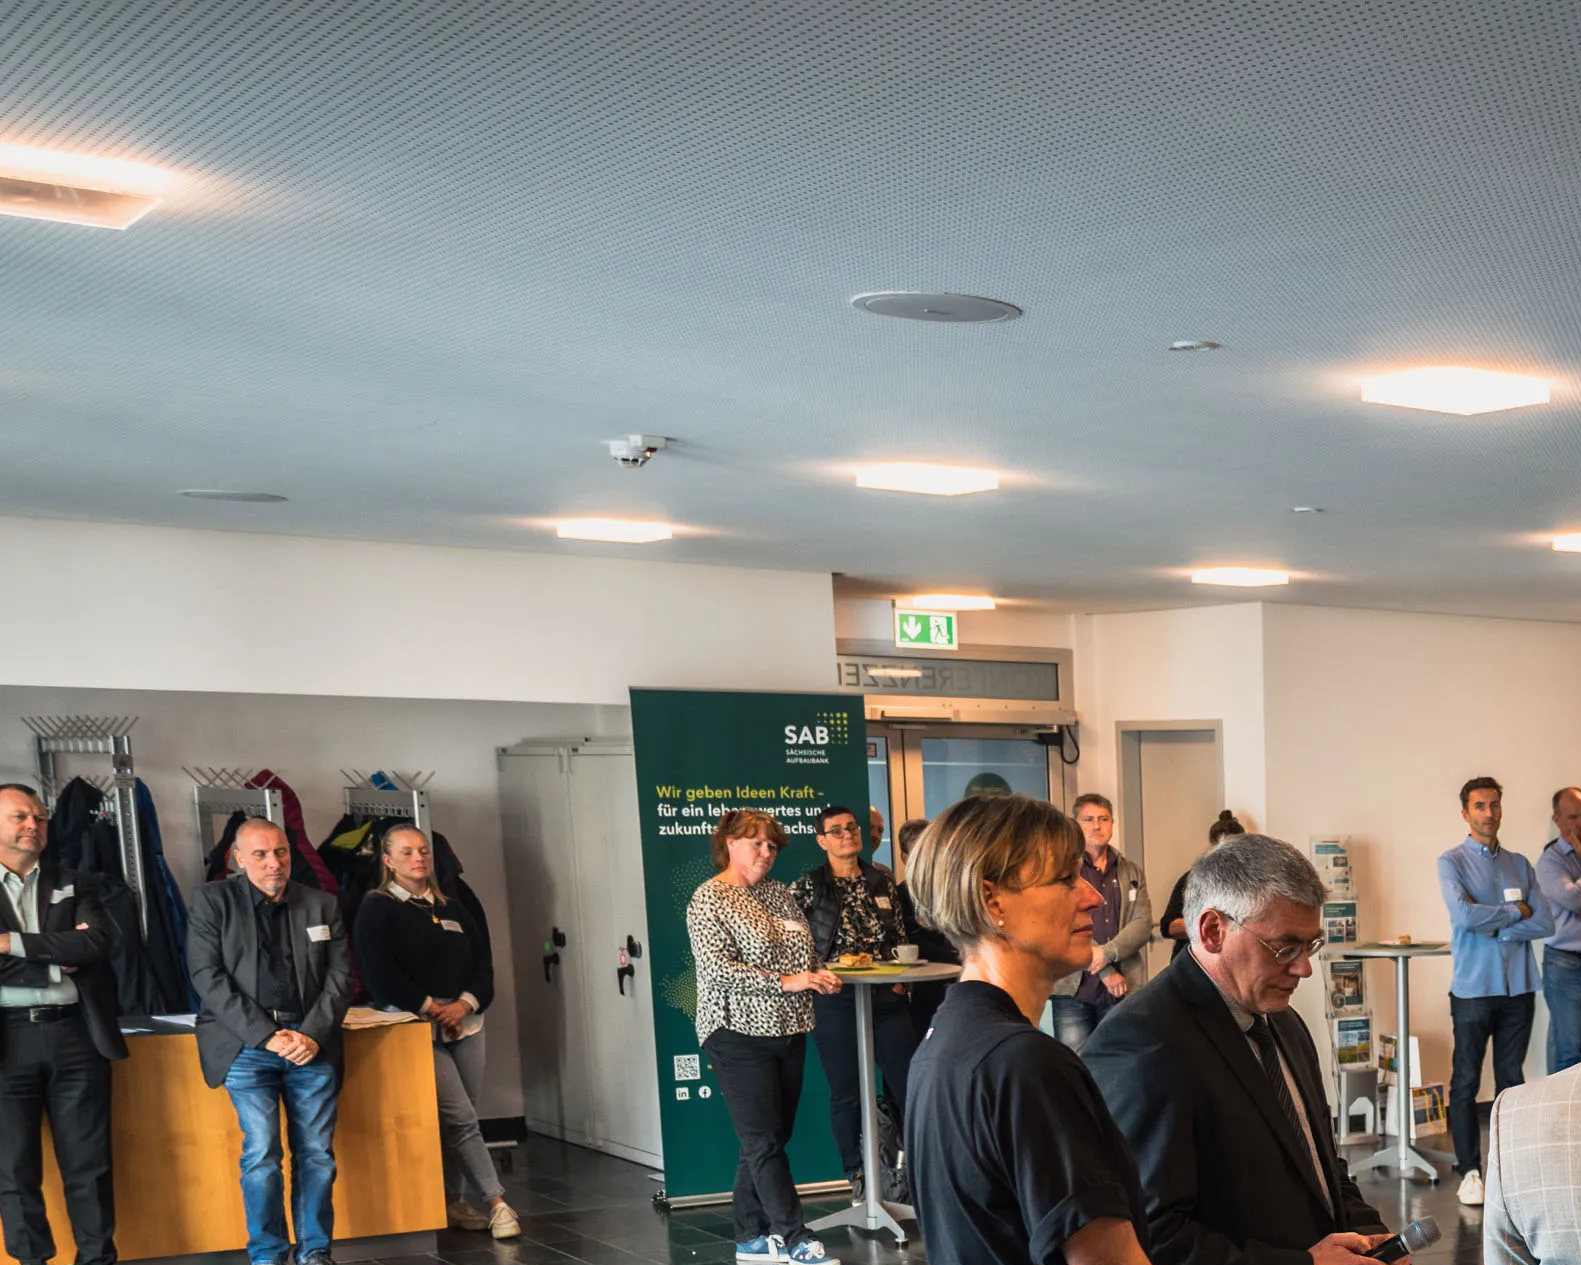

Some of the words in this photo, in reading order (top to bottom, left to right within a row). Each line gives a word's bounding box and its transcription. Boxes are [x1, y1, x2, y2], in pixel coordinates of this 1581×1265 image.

[784, 725, 829, 745] SAB
[786, 748, 825, 756] SÄCHSISCHE
[656, 785, 682, 798] Wir
[686, 785, 732, 802] geben
[736, 785, 776, 799] Ideen
[780, 785, 815, 799] Kraft
[657, 803, 678, 817] für
[681, 803, 704, 817] ein
[805, 803, 831, 817] un
